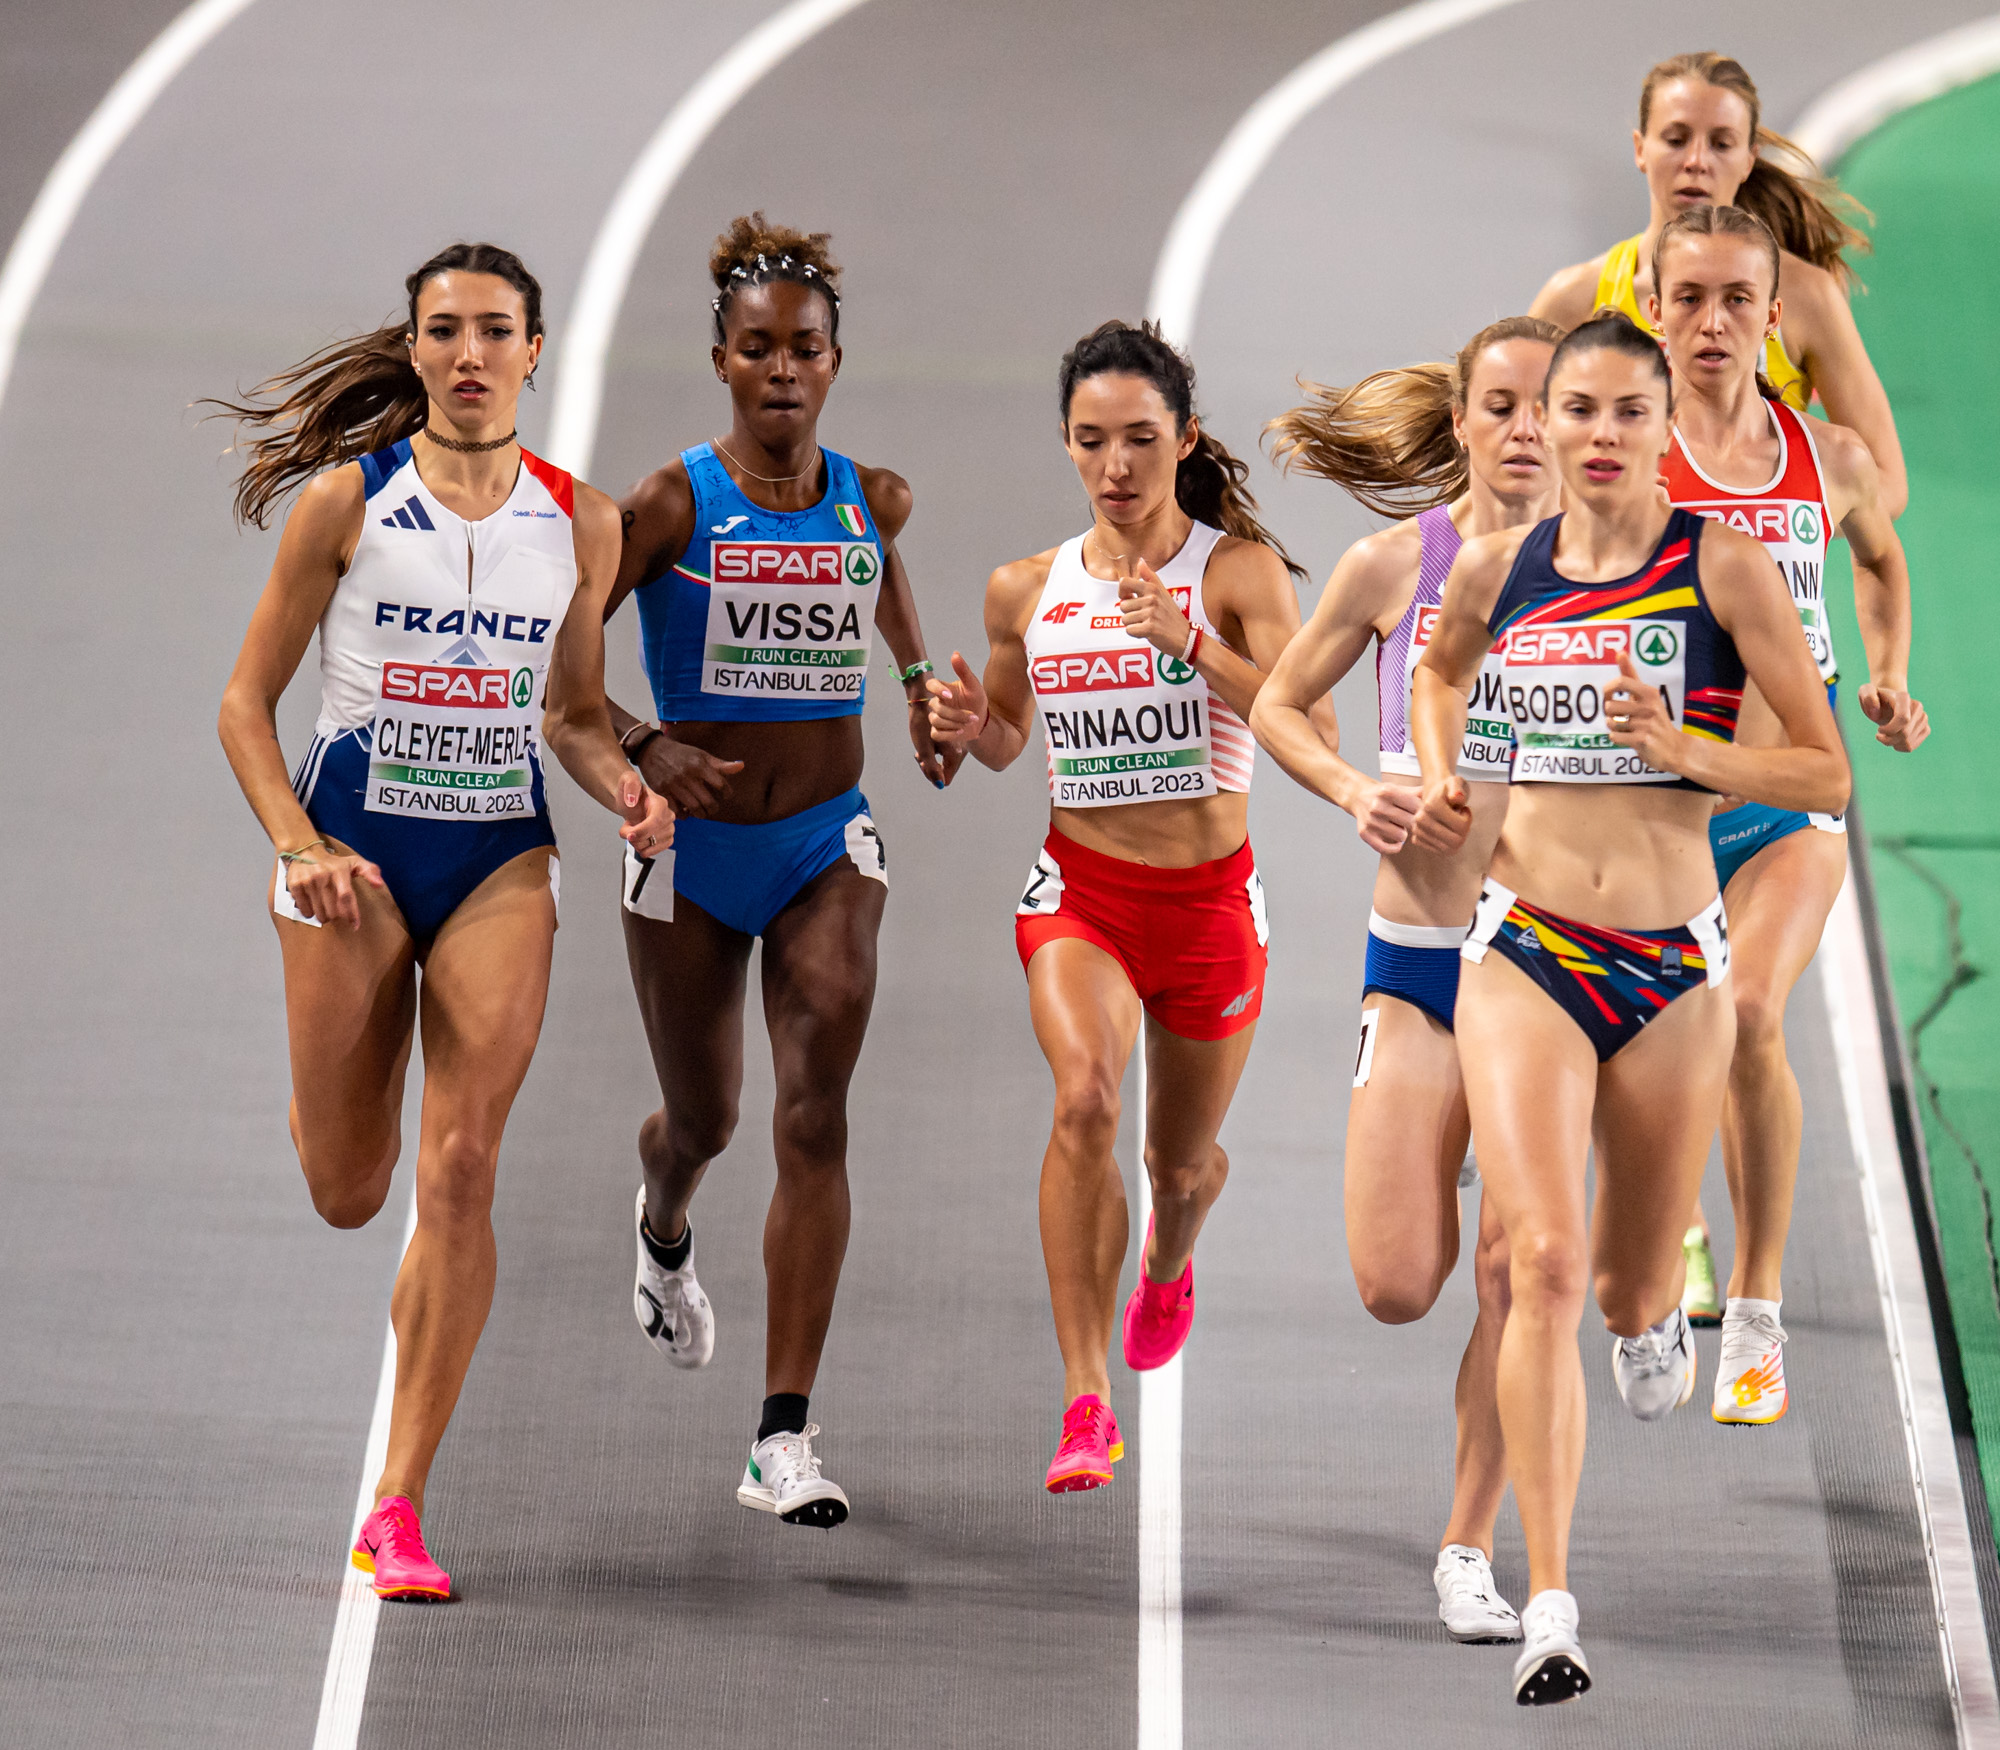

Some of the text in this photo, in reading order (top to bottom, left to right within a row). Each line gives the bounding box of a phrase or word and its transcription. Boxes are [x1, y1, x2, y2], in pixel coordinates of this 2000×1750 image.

[718, 549, 839, 579] SPAR
[375, 601, 552, 643] FRANCE
[725, 601, 861, 642] VISSA
[1042, 602, 1086, 624] 4F
[742, 649, 748, 662] I
[751, 650, 785, 663] RUN
[1509, 630, 1628, 661] SPAR
[385, 667, 507, 703] SPAR
[714, 668, 863, 692] ISTANBUL 2023
[1033, 653, 1151, 690] SPAR
[1044, 700, 1202, 749] ENNAOUI
[407, 768, 412, 781] I
[416, 770, 451, 785] RUN
[1070, 761, 1075, 773] I
[1077, 758, 1111, 773] RUN
[1521, 755, 1610, 776] ISTANBUL
[1061, 772, 1205, 800] ISTANBUL 2023
[378, 787, 525, 814] ISTANBUL 2023
[1718, 825, 1761, 845] CRAFT
[1221, 985, 1257, 1018] 4F
